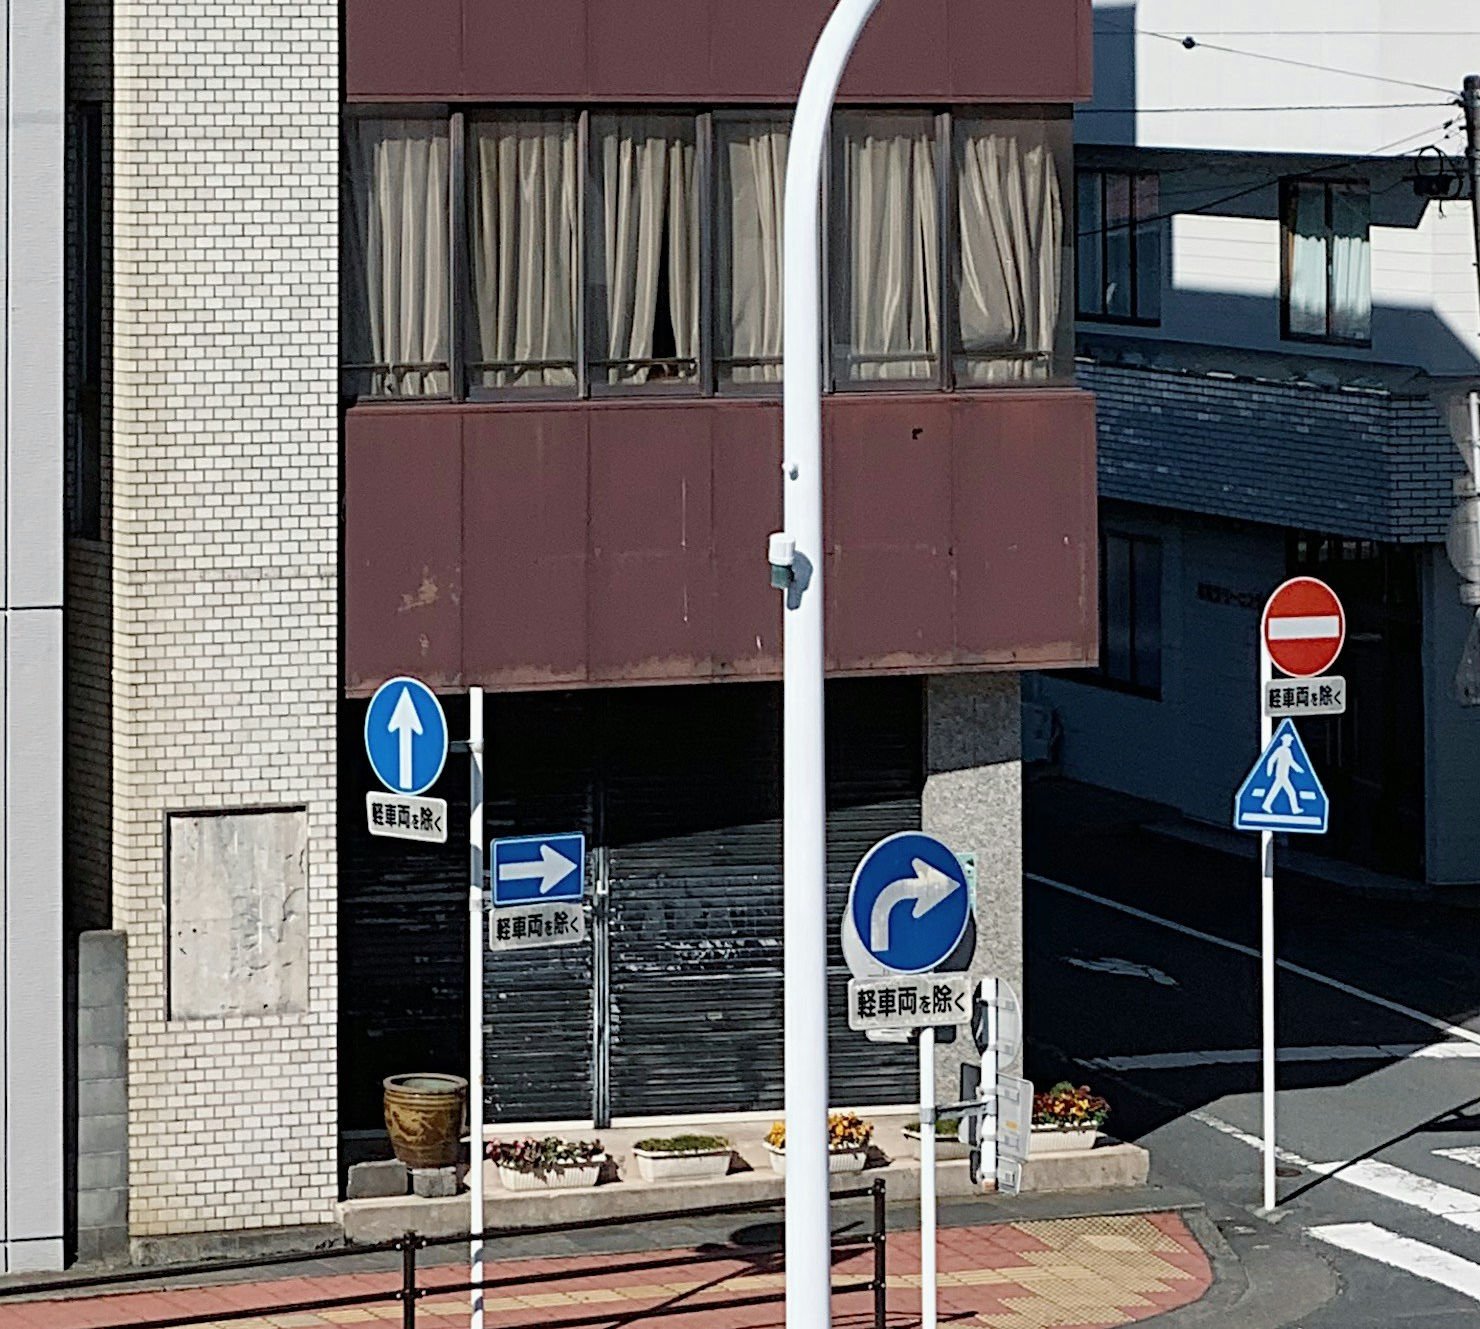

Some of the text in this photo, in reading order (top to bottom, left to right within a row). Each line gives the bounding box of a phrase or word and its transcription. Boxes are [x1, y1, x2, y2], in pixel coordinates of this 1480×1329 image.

[1269, 685, 1341, 708] 軽車両を除く
[371, 802, 442, 832] 軽車両を除く
[496, 911, 579, 942] 軽車両を除く
[857, 984, 965, 1019] 軽車両を除く
